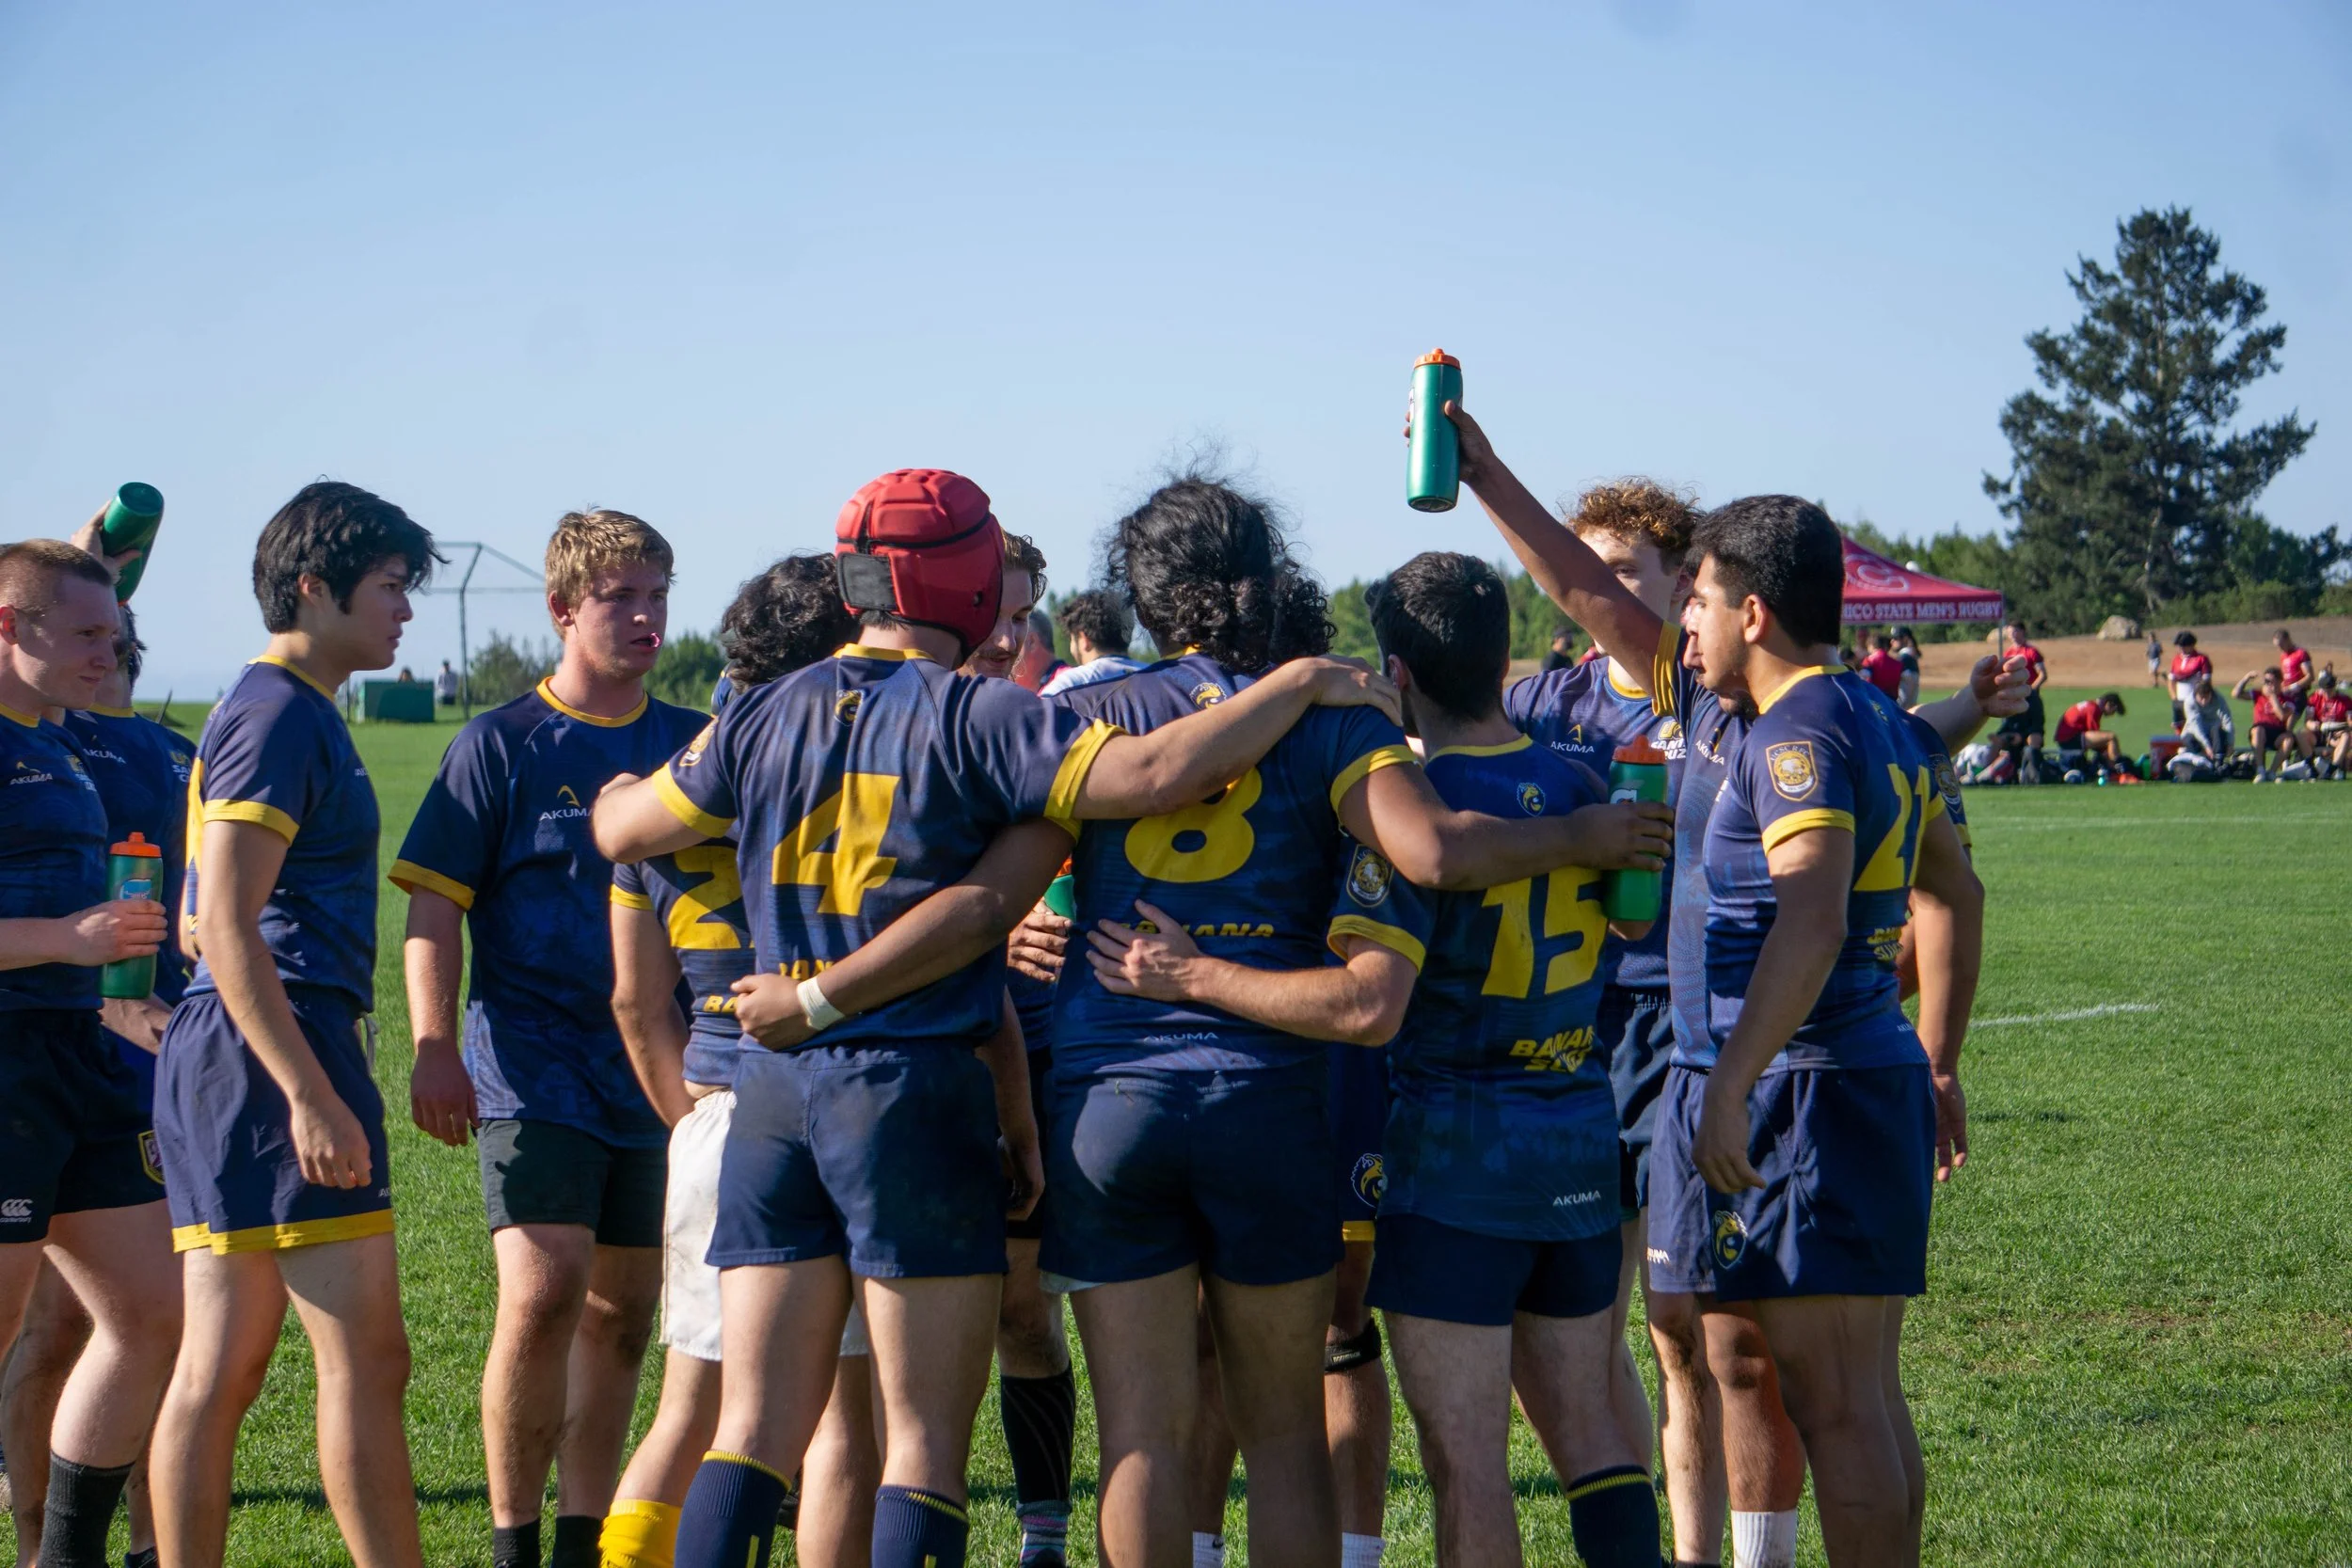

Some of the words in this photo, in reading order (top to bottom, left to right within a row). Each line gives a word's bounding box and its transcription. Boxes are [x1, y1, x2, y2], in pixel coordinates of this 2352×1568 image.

[1875, 602, 1914, 620] STATE
[1916, 602, 1957, 619] MEN'S
[1959, 601, 2002, 618] RUGBY
[1550, 740, 1596, 753] AKUMA
[1695, 739, 1725, 767] AKUMA
[9, 772, 54, 785] AKUMA
[1124, 766, 1263, 884] 8
[1852, 763, 1931, 892] 21
[771, 771, 902, 916] 4
[1481, 864, 1607, 999] 15
[1143, 1032, 1220, 1042] AKUMA
[1552, 1189, 1601, 1207] AKUMA
